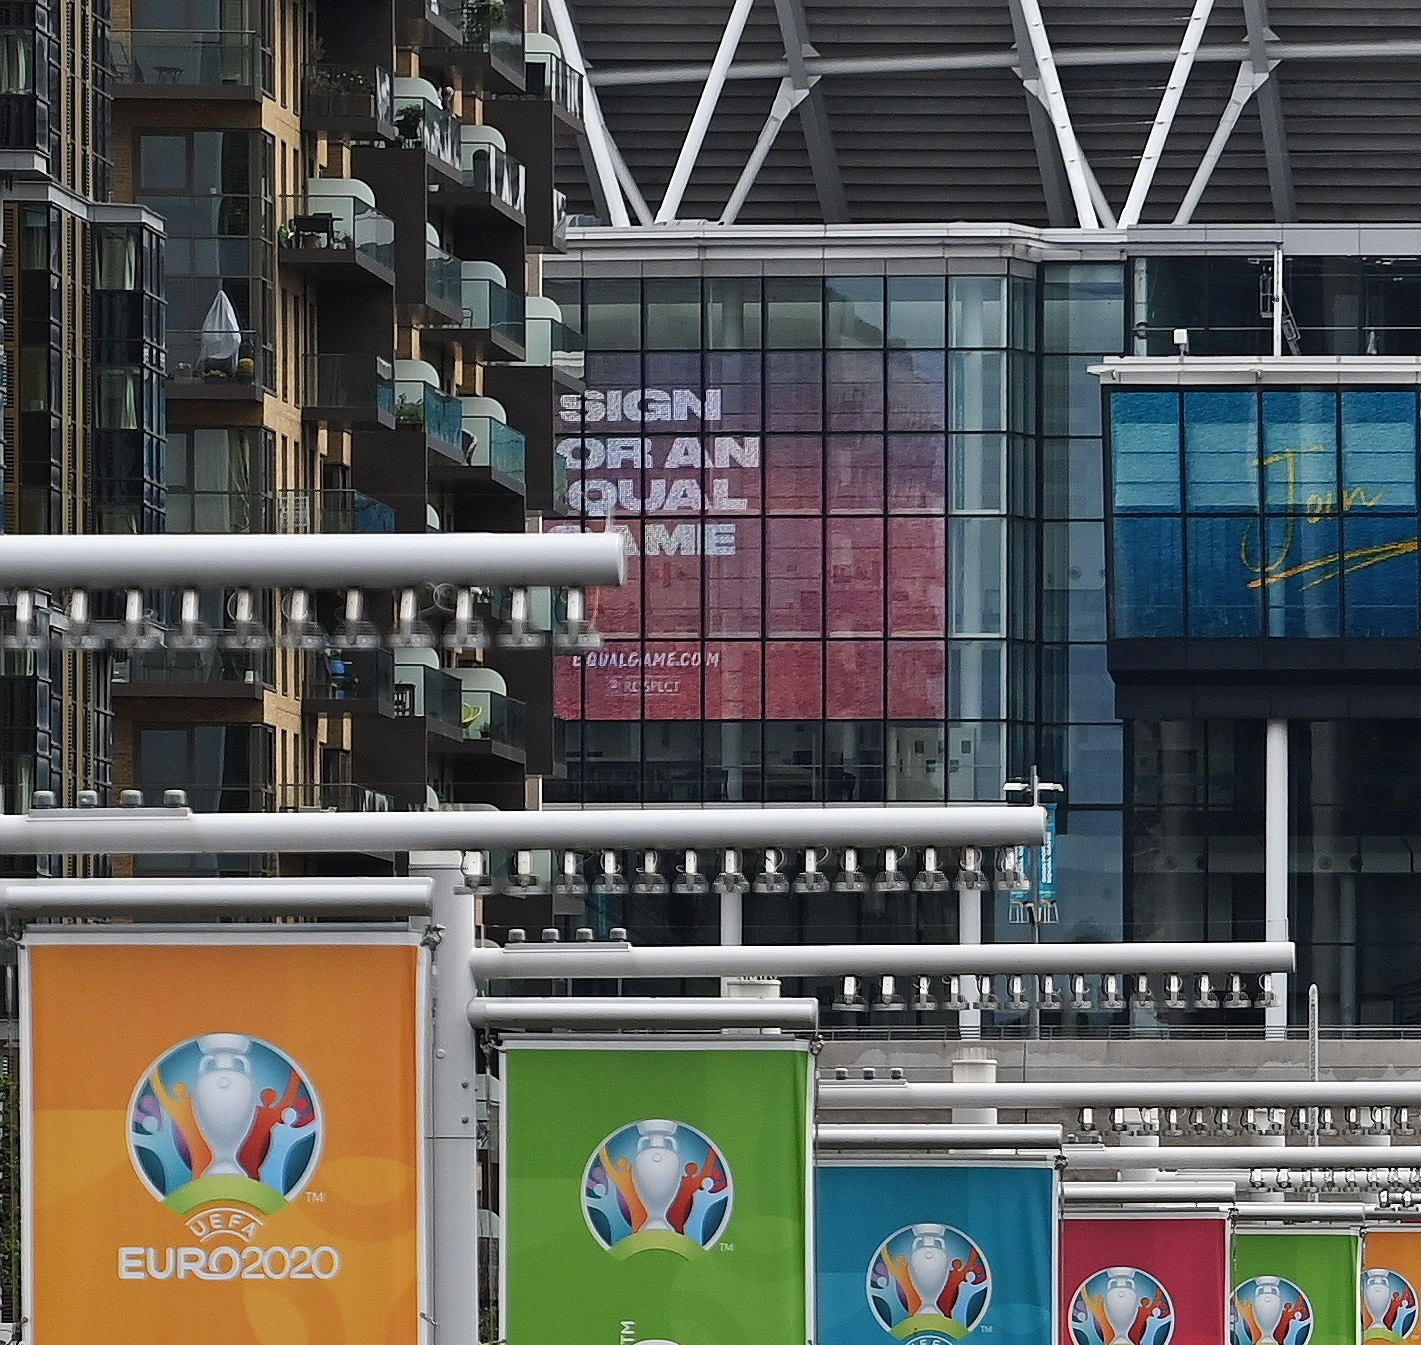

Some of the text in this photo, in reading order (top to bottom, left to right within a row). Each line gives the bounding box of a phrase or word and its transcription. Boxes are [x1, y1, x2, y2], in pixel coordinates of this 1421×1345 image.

[559, 387, 722, 421] SIGN
[557, 437, 760, 469] OR AN
[563, 479, 748, 520] QUAL
[560, 523, 737, 556] AME
[189, 1213, 258, 1237] UEFA
[118, 1246, 341, 1279] EURO2020
